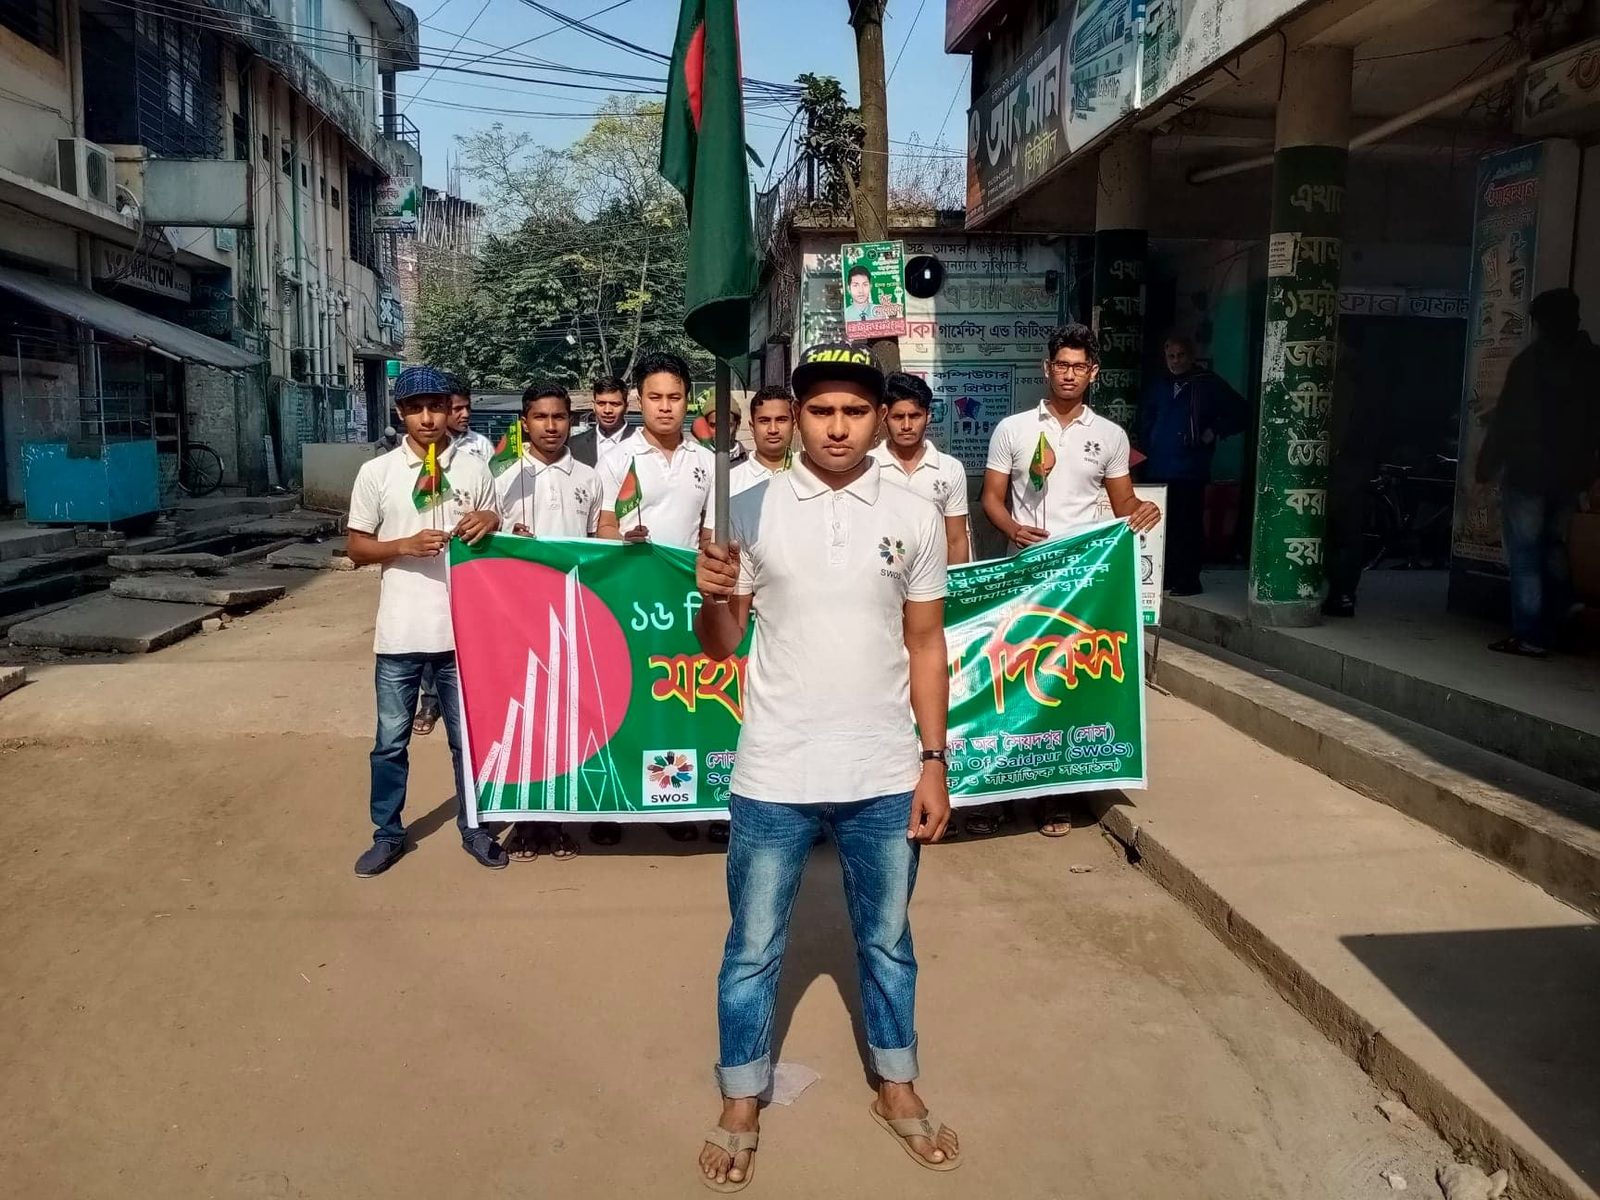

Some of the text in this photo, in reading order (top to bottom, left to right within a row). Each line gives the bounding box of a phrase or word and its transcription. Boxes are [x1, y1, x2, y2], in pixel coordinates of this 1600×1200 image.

[932, 243, 969, 255] আমরা
[1283, 488, 1328, 516] করা
[880, 568, 902, 580] SWOS
[630, 600, 675, 632] ১৬
[982, 604, 1128, 715] দিবস
[968, 757, 993, 771] Of
[996, 750, 1062, 770] Saidpur
[1065, 742, 1135, 763] (SWOS)
[650, 793, 690, 804] SWOS
